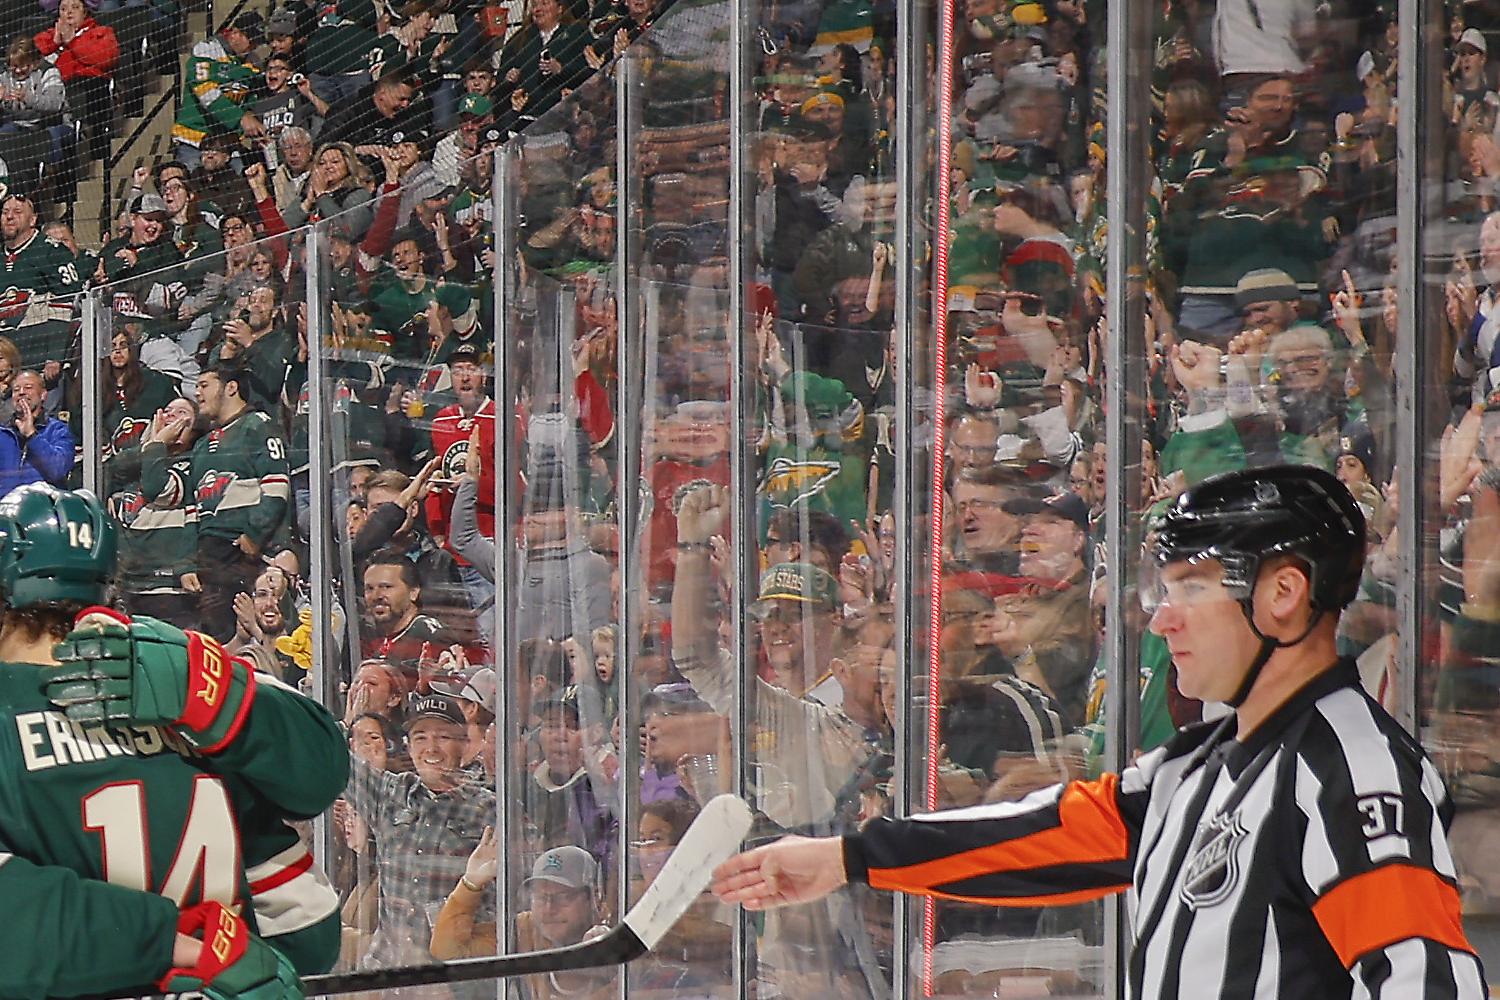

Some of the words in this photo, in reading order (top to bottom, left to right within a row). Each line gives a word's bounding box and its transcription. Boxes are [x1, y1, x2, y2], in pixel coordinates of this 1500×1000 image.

[67, 520, 94, 550] 14
[415, 697, 448, 712] WILD
[1357, 797, 1404, 840] 37
[82, 774, 242, 905] 14
